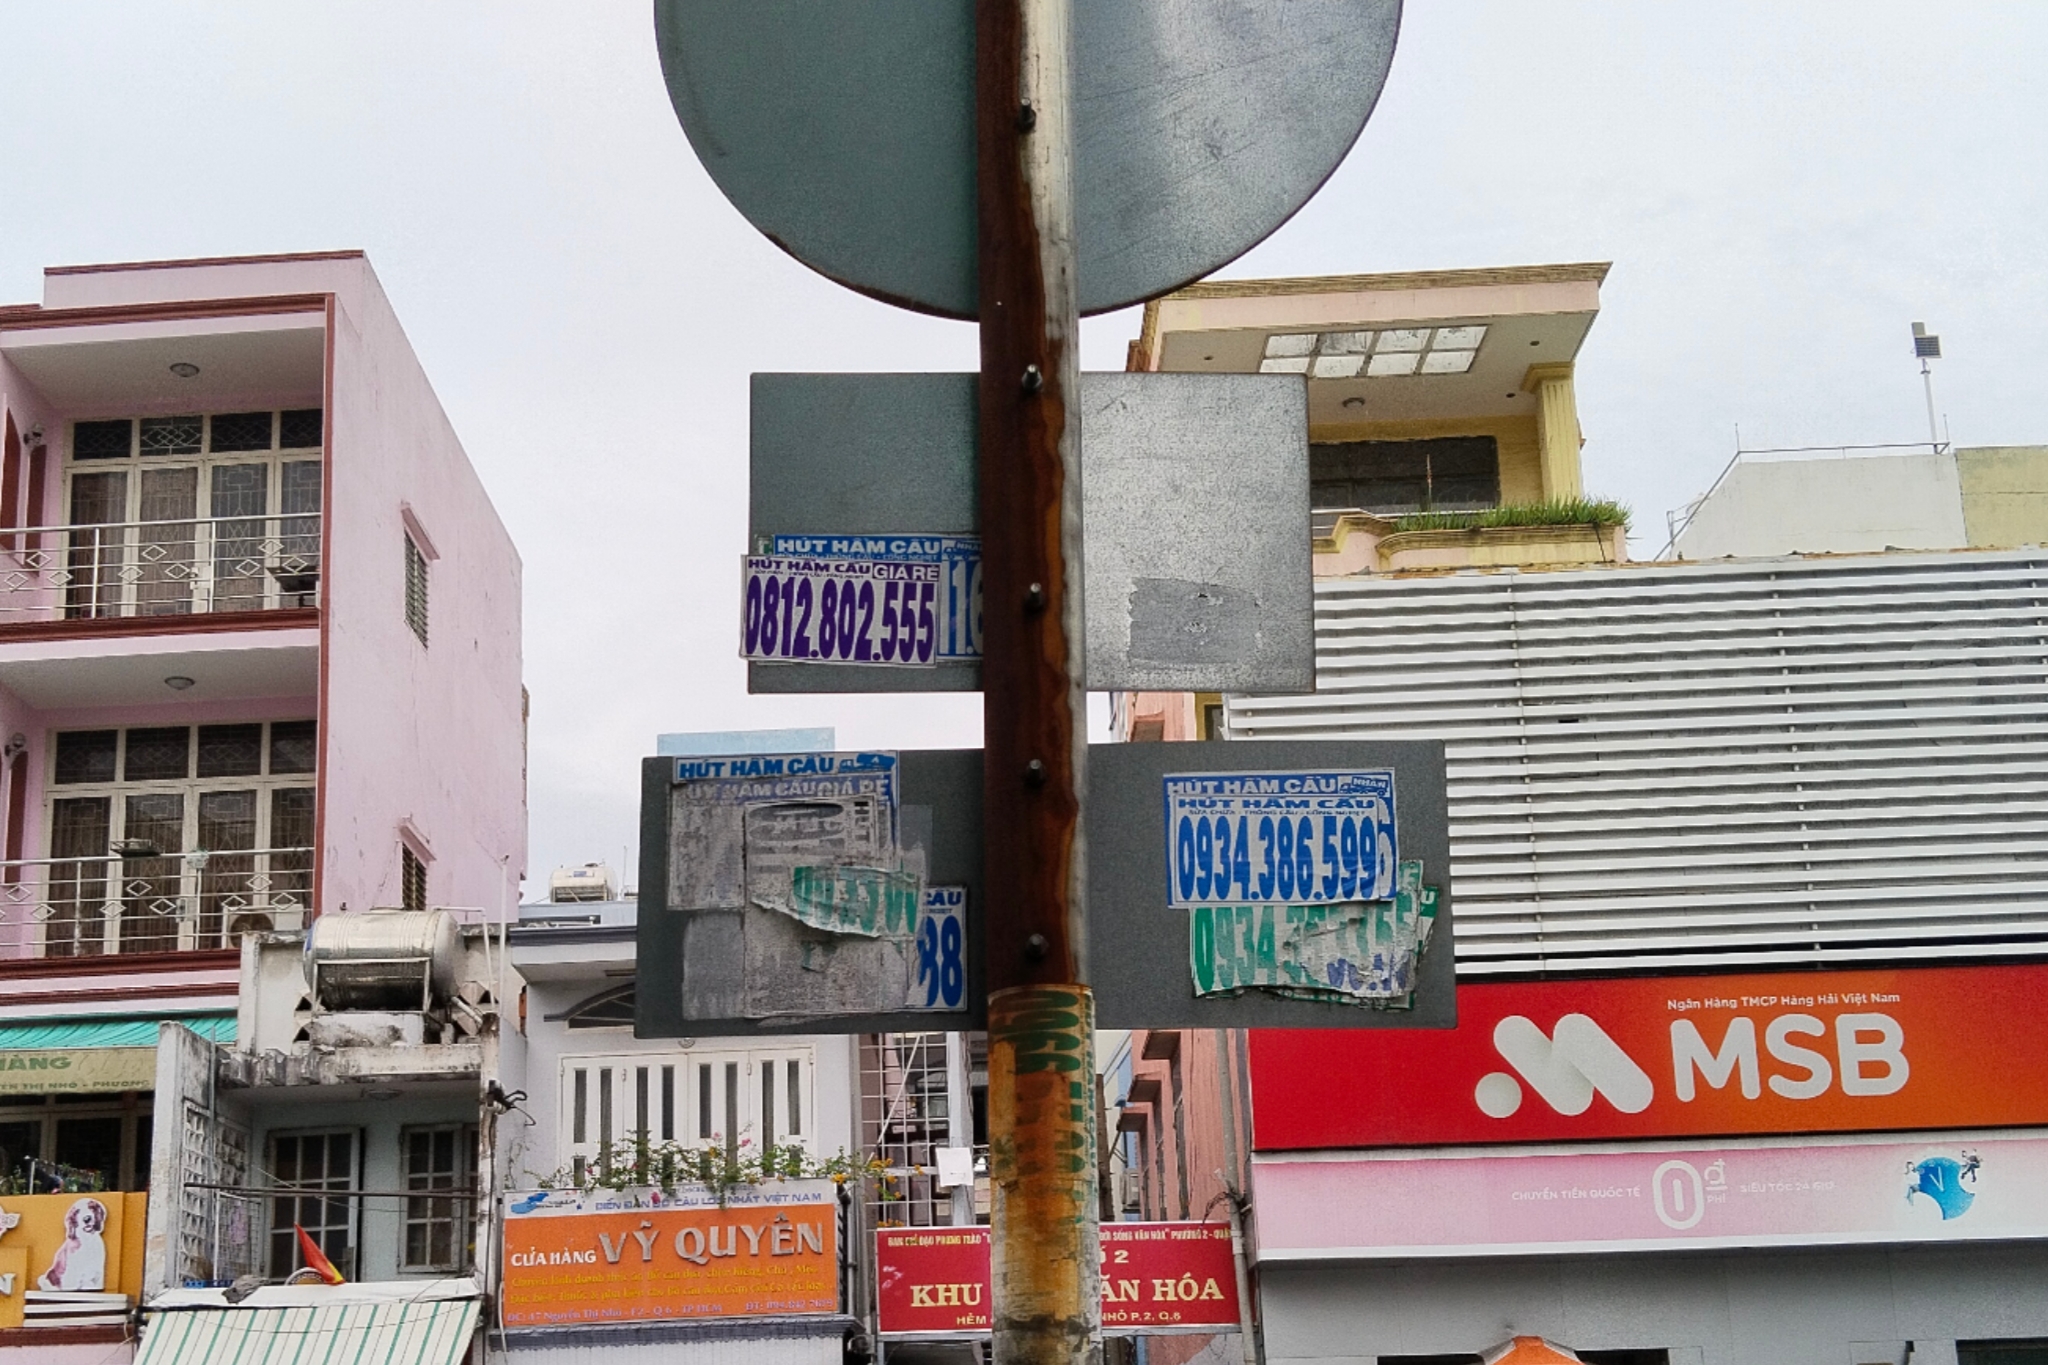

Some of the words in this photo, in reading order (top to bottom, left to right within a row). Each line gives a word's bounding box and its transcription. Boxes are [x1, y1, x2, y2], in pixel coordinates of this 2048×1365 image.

[777, 537, 827, 553] HÚT
[832, 538, 886, 554] HẦM
[890, 539, 940, 555] CẦU
[748, 557, 784, 570] HÚT
[787, 560, 830, 573] HẦM
[834, 561, 871, 574] CẦU
[873, 564, 908, 579] GIÁ
[912, 564, 939, 581] RẺ
[746, 575, 935, 662] 0812.802.555
[679, 760, 726, 779] HÚT
[730, 758, 783, 776] HẦM
[787, 755, 834, 773] CẦU
[1167, 779, 1219, 795] HÚT
[1223, 777, 1279, 794] HẦM
[1284, 776, 1336, 793] CẦU
[1178, 797, 1234, 808] HÚT
[1178, 815, 1377, 900] 0934.386.599
[1668, 999, 1701, 1010] Ngân
[1704, 997, 1738, 1009] Hàng
[1741, 997, 1778, 1006] TMCP
[1781, 995, 1814, 1006] Hàng
[1818, 994, 1839, 1004] Hải
[1841, 993, 1867, 1004] Việt
[1871, 993, 1900, 1003] Nam
[1670, 1013, 1910, 1102] MSB
[675, 1211, 823, 1265] QUYÊN
[550, 1247, 597, 1265] HÀNG
[1114, 1250, 1129, 1263] 2
[910, 1283, 983, 1307] KHU
[1152, 1272, 1225, 1301] HÓA
[956, 1312, 986, 1325] HẺM
